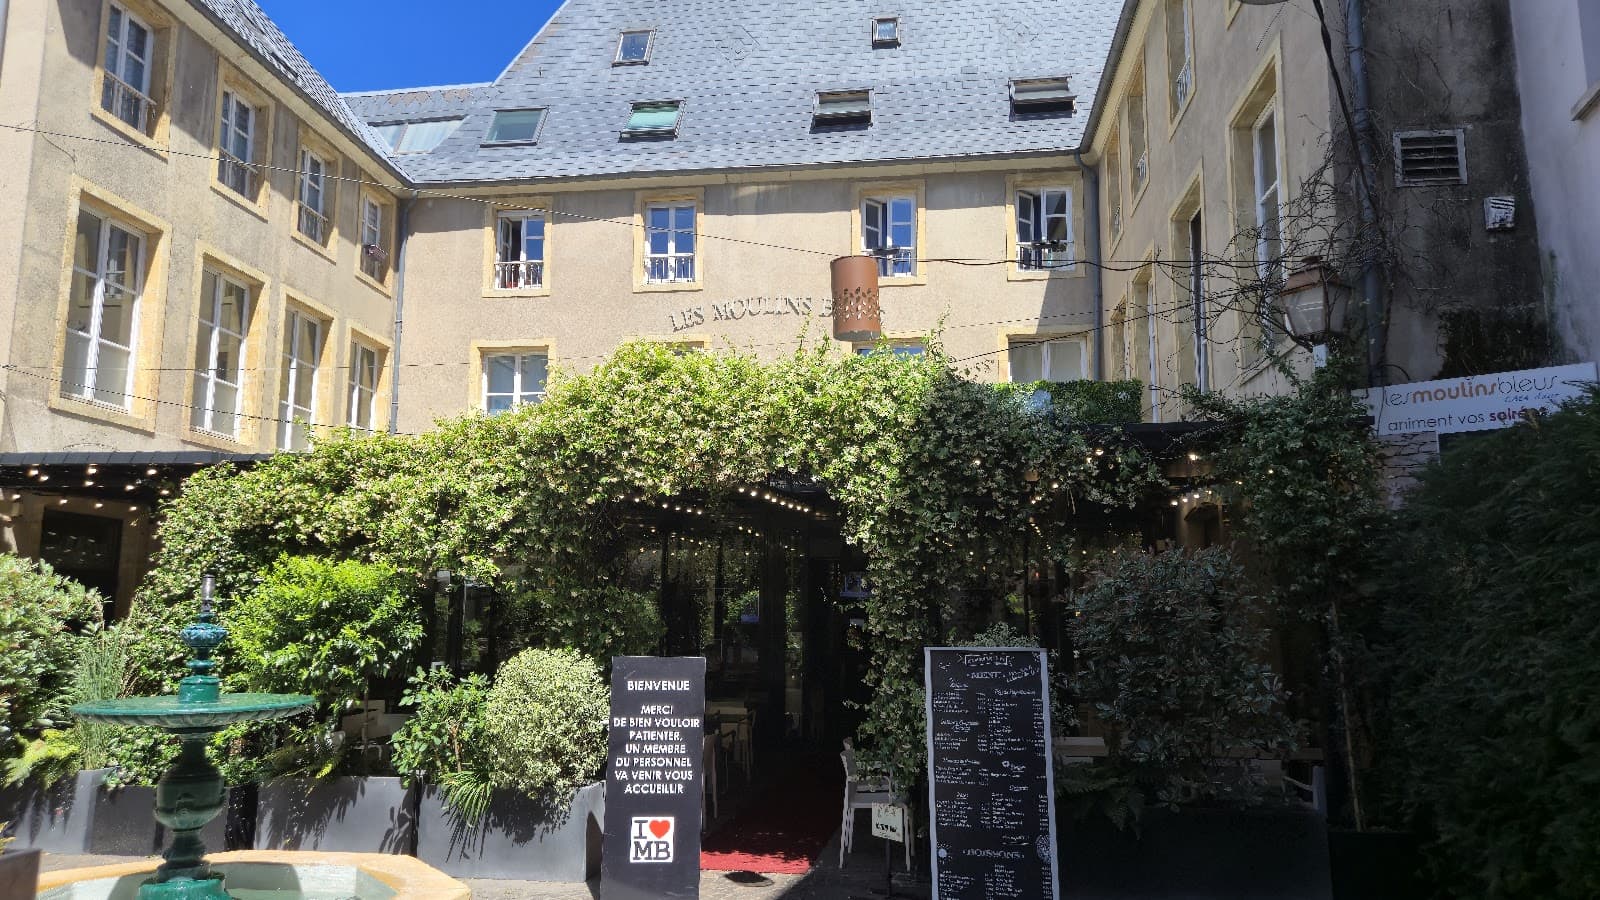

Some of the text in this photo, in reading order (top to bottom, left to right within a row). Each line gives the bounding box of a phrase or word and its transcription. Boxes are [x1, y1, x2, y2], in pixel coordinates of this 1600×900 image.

[669, 307, 705, 332] LES
[712, 296, 812, 322] MOULINS
[1388, 413, 1453, 432] animent
[1458, 413, 1485, 425] vos
[627, 680, 690, 691] BIENVENUE
[640, 704, 673, 715] MERCI
[613, 717, 700, 728] DE BIEN VOULOIR
[629, 730, 683, 741] PATIENTER,
[625, 743, 686, 754] UN MEMBRE
[615, 757, 692, 767] DU PERSONNEL
[614, 770, 694, 781] VA VENIR VOUS
[624, 783, 684, 794] ACCUEILLIR
[632, 840, 671, 861] MB
